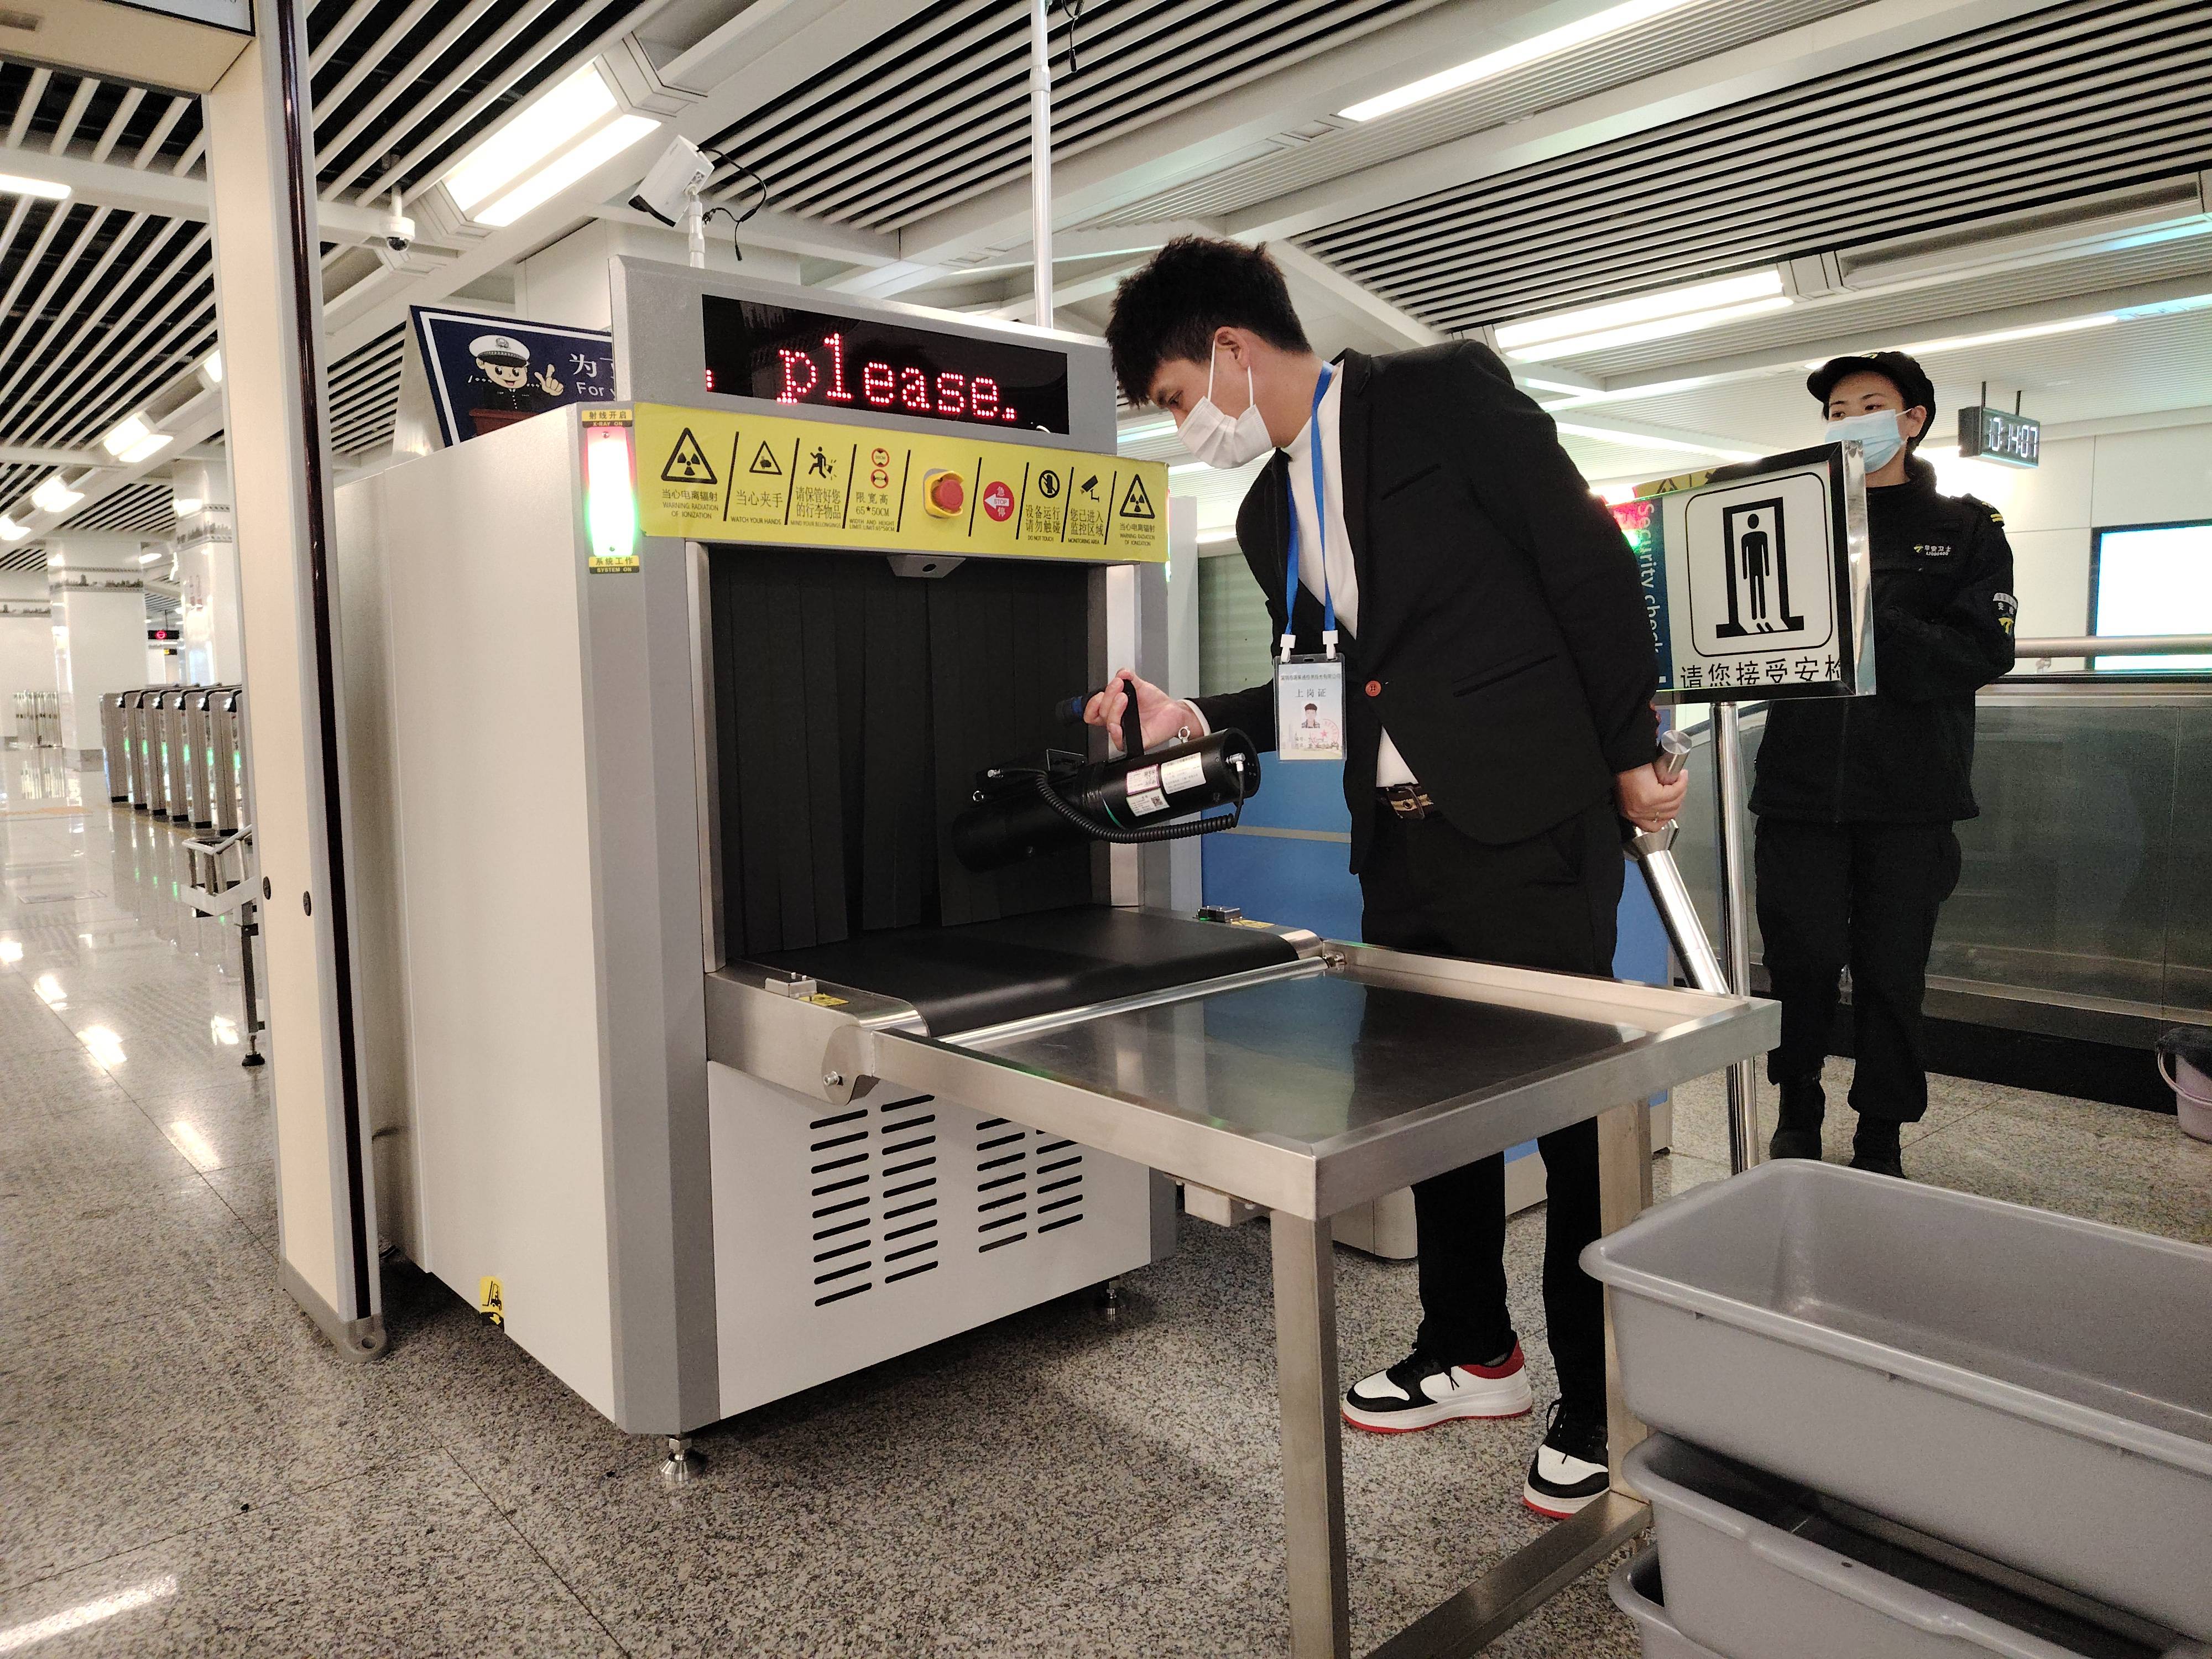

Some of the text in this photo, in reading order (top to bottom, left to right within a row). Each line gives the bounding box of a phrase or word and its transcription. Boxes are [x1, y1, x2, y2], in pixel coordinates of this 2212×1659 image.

[776, 332, 1017, 420] please.
[576, 382, 604, 397] For
[589, 411, 627, 420] 射线开启
[1988, 417, 2038, 458] 10:14:07
[662, 488, 717, 502] 当心电离辐射
[736, 489, 783, 508] 当心夹手
[796, 486, 841, 504] 请保管好您
[856, 492, 888, 505] 限宽高
[997, 486, 1005, 497] 急
[796, 502, 841, 519] 的行李物品
[998, 506, 1005, 517] 停
[1026, 504, 1060, 520] 设备运行
[1071, 508, 1103, 523] 您已进入
[1026, 519, 1061, 534] 请勿触碰
[1071, 522, 1104, 536] 监控区域
[1120, 523, 1155, 533] 当心电离辐射
[1637, 503, 1657, 588] Security
[596, 557, 633, 565] 系统工作
[1681, 654, 1840, 688] 请您接受安检
[1295, 688, 1327, 698] 上岗证
